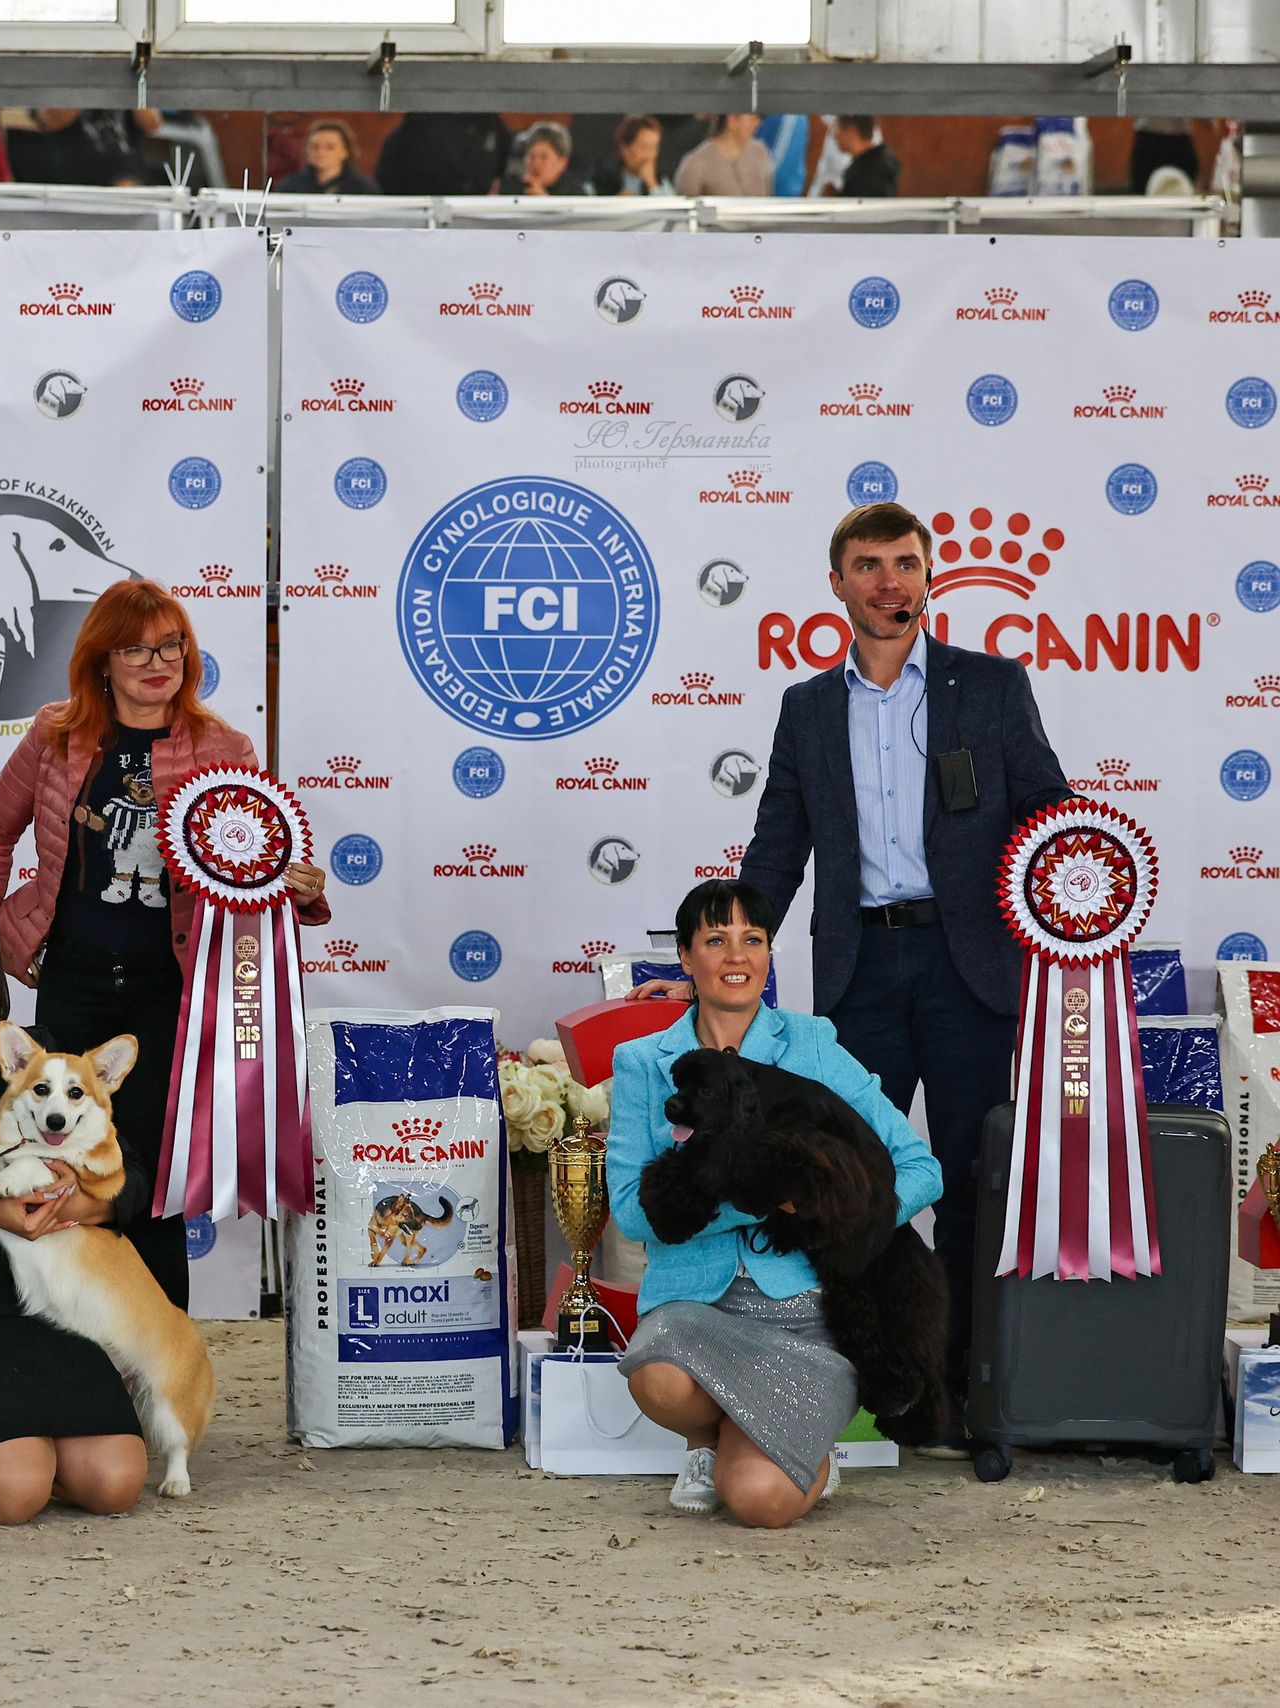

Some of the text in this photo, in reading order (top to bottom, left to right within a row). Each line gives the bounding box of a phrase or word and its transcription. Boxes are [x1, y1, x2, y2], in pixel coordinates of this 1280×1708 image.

[186, 291, 207, 302] FCI
[352, 292, 373, 303] FCI
[19, 303, 63, 316] ROYAL
[439, 303, 483, 316] ROYAL
[1124, 300, 1144, 311] FCI
[956, 307, 998, 321] ROYAL
[473, 391, 493, 402] FCI
[1242, 397, 1262, 408] FCI
[142, 398, 184, 412] ROYAL
[559, 401, 601, 414] ROYAL
[1074, 405, 1116, 419] ROYAL
[185, 478, 206, 489] FCI
[863, 482, 883, 493] FCI
[699, 490, 741, 504] ROYAL
[25, 481, 115, 552] KAZAKHSTAN
[171, 585, 214, 599] ROYAL
[1251, 581, 1271, 592] FCI
[413, 491, 645, 726] FEDERATION CYNOLOGIQUE INTERNATIONALE
[484, 586, 578, 631] FCI
[652, 692, 694, 706] ROYAL
[556, 777, 599, 791] ROYAL
[1068, 779, 1110, 792] ROYAL
[347, 855, 367, 865] FCI
[433, 864, 476, 878] ROYAL
[466, 951, 486, 961] FCI
[235, 1025, 261, 1042] BIS
[240, 1043, 257, 1059] III
[1064, 1081, 1089, 1097] BIS
[1069, 1099, 1085, 1115] IV
[353, 1144, 416, 1163] ROYAL
[1238, 1091, 1250, 1206] OFESSIONAL
[314, 1176, 329, 1330] PROFESSIONAL
[384, 1280, 449, 1303] maxi
[357, 1295, 373, 1321] L
[384, 1310, 427, 1324] adult
